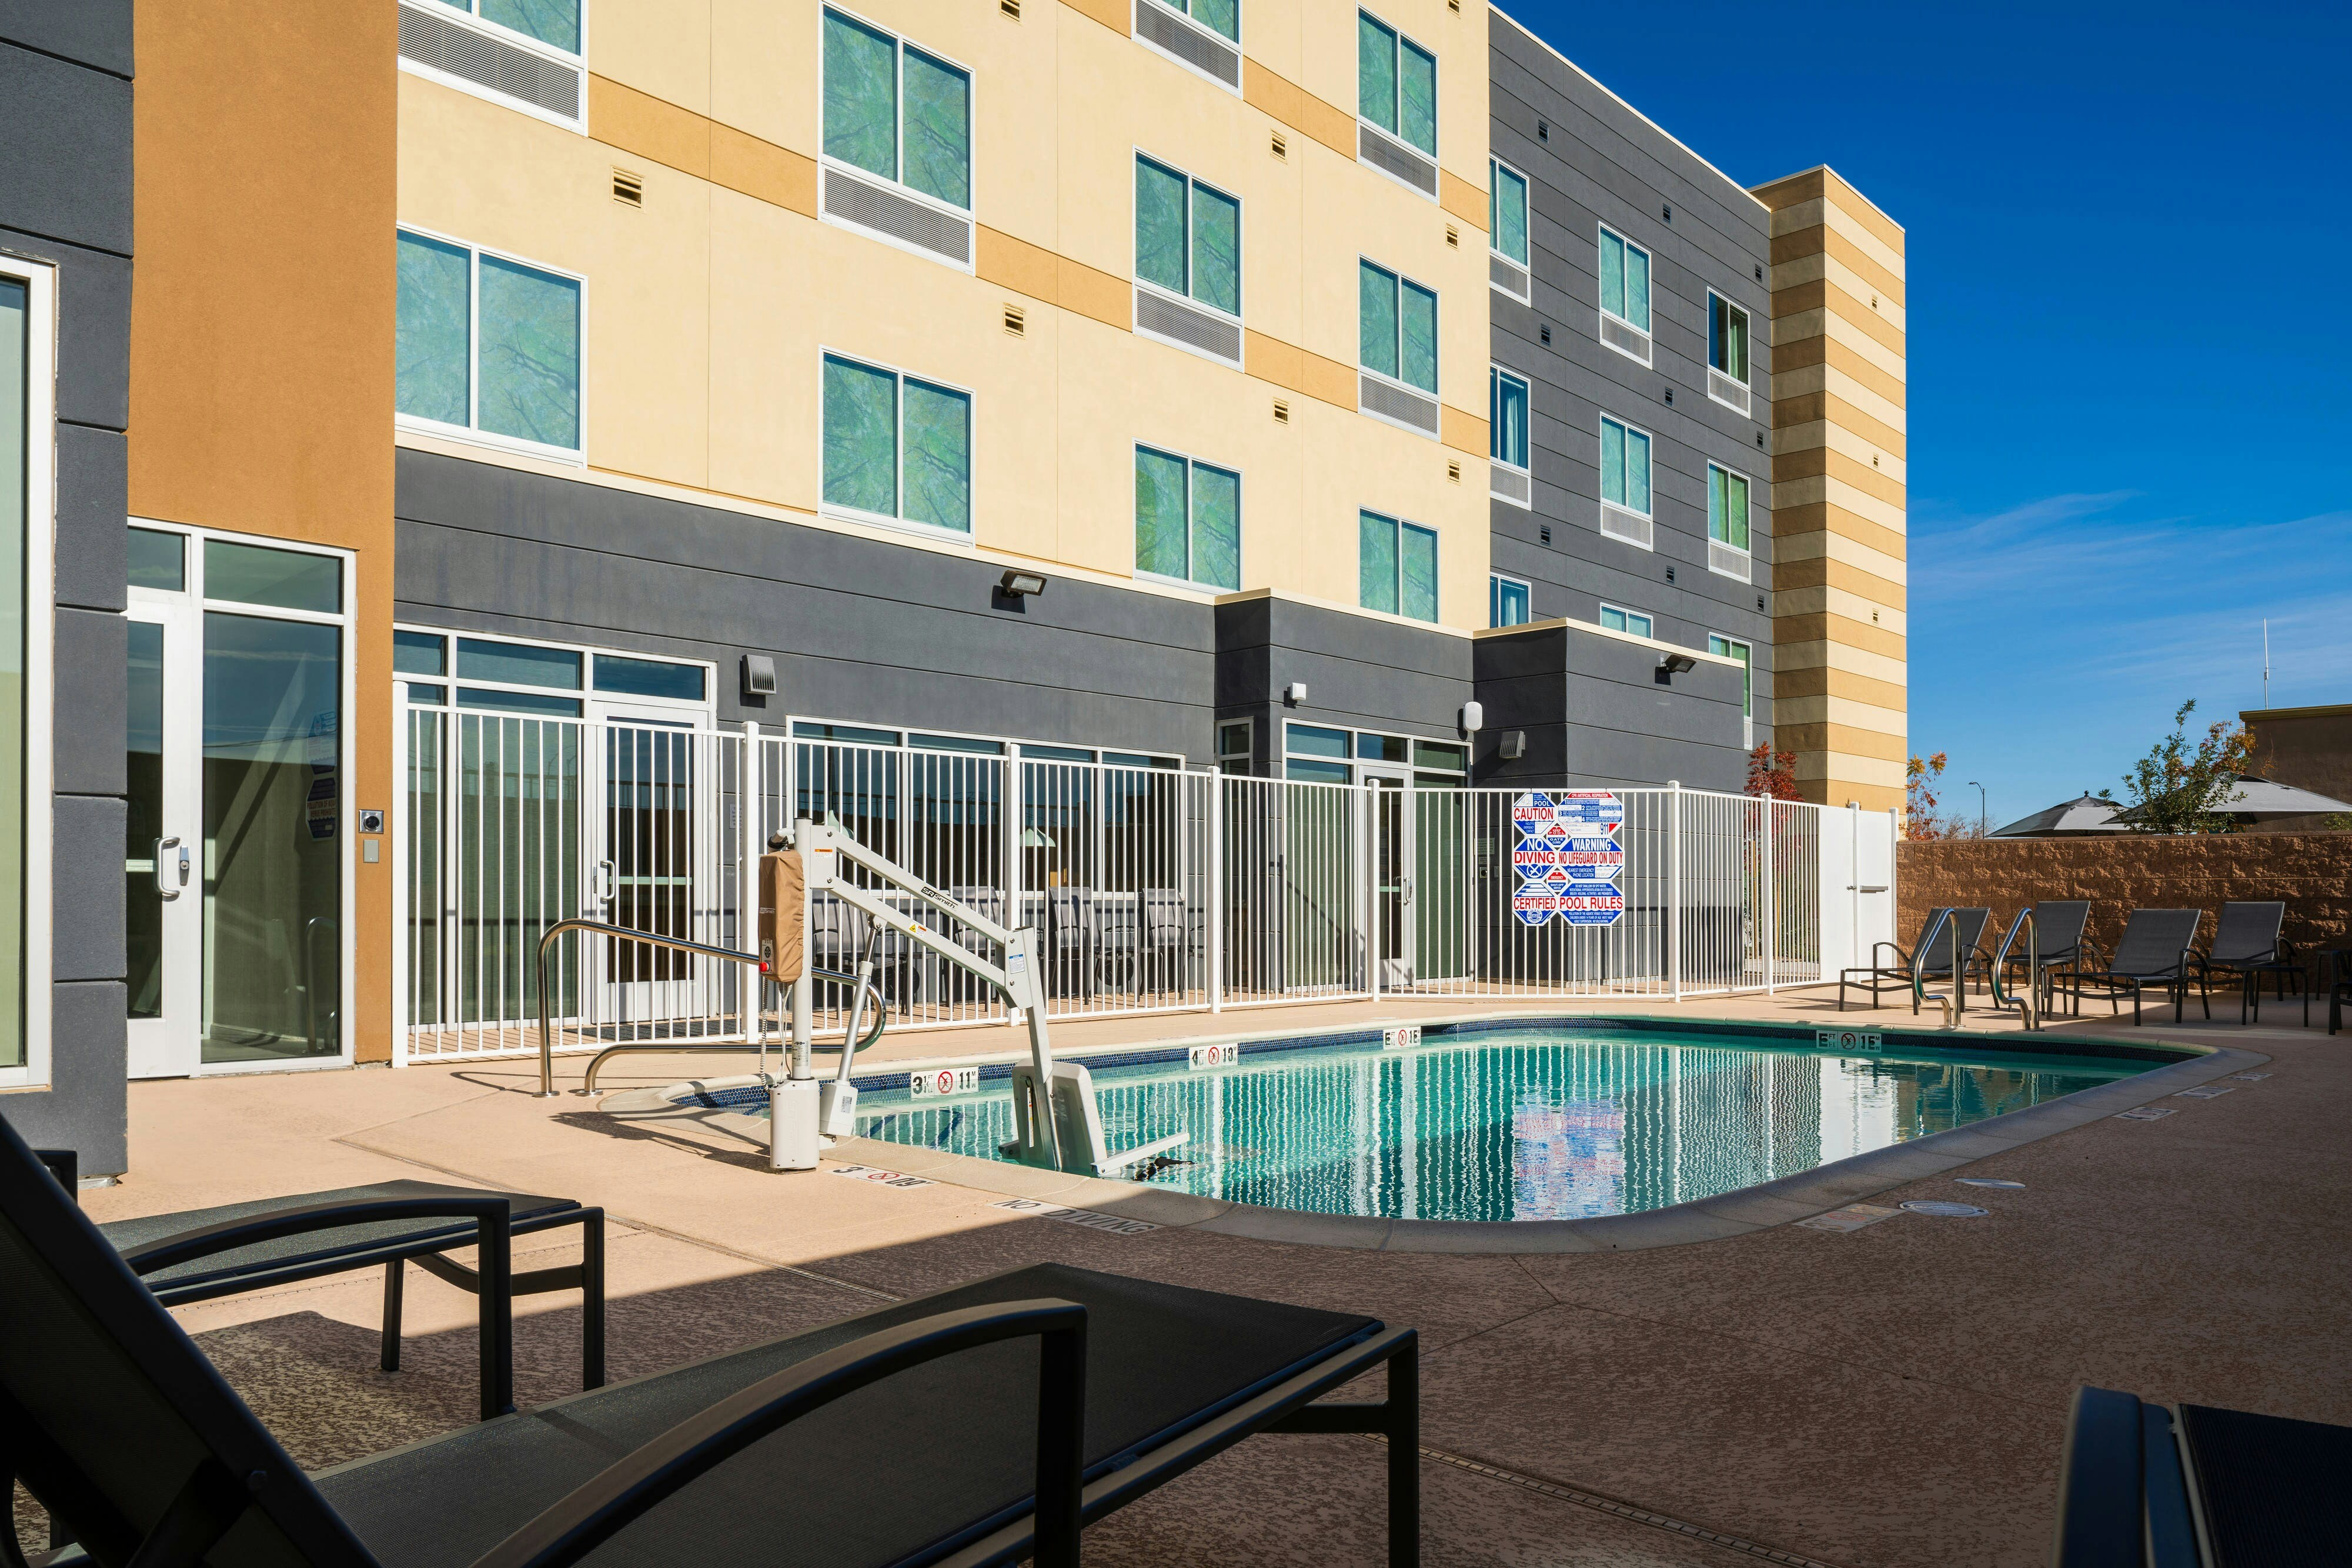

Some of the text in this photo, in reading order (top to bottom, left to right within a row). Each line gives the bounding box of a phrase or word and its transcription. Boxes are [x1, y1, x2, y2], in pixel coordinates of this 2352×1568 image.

[1514, 808, 1553, 820] CAUTION
[1600, 823, 1609, 835] 911
[1527, 838, 1544, 851] NO
[1572, 838, 1611, 851] WARNING
[1514, 852, 1555, 864] DIVING
[1559, 852, 1623, 864] NO LIFEGUARD ON DUTY
[921, 887, 956, 908] SR Smith
[1560, 897, 1623, 909] POOL RULES
[1514, 898, 1556, 910] CERTIFIED
[993, 1199, 1155, 1233] NO DIVING
